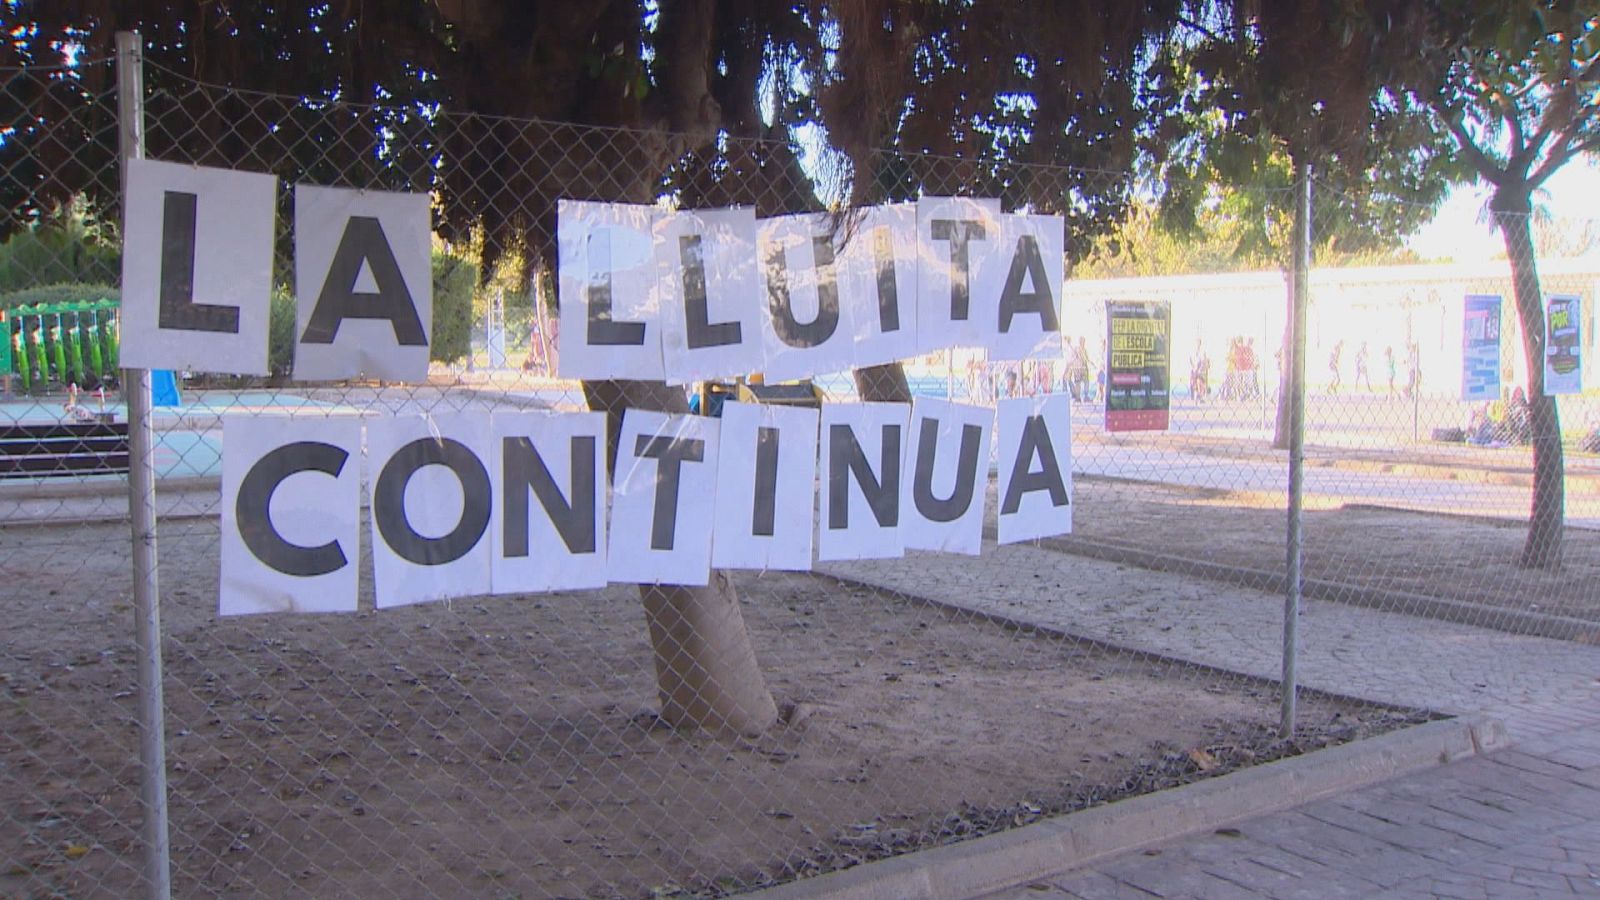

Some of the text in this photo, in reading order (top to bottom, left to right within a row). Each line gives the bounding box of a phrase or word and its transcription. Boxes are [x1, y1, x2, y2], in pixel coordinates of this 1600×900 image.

[158, 190, 1061, 350] LA LLUITA
[235, 414, 1070, 578] CONTINUA
